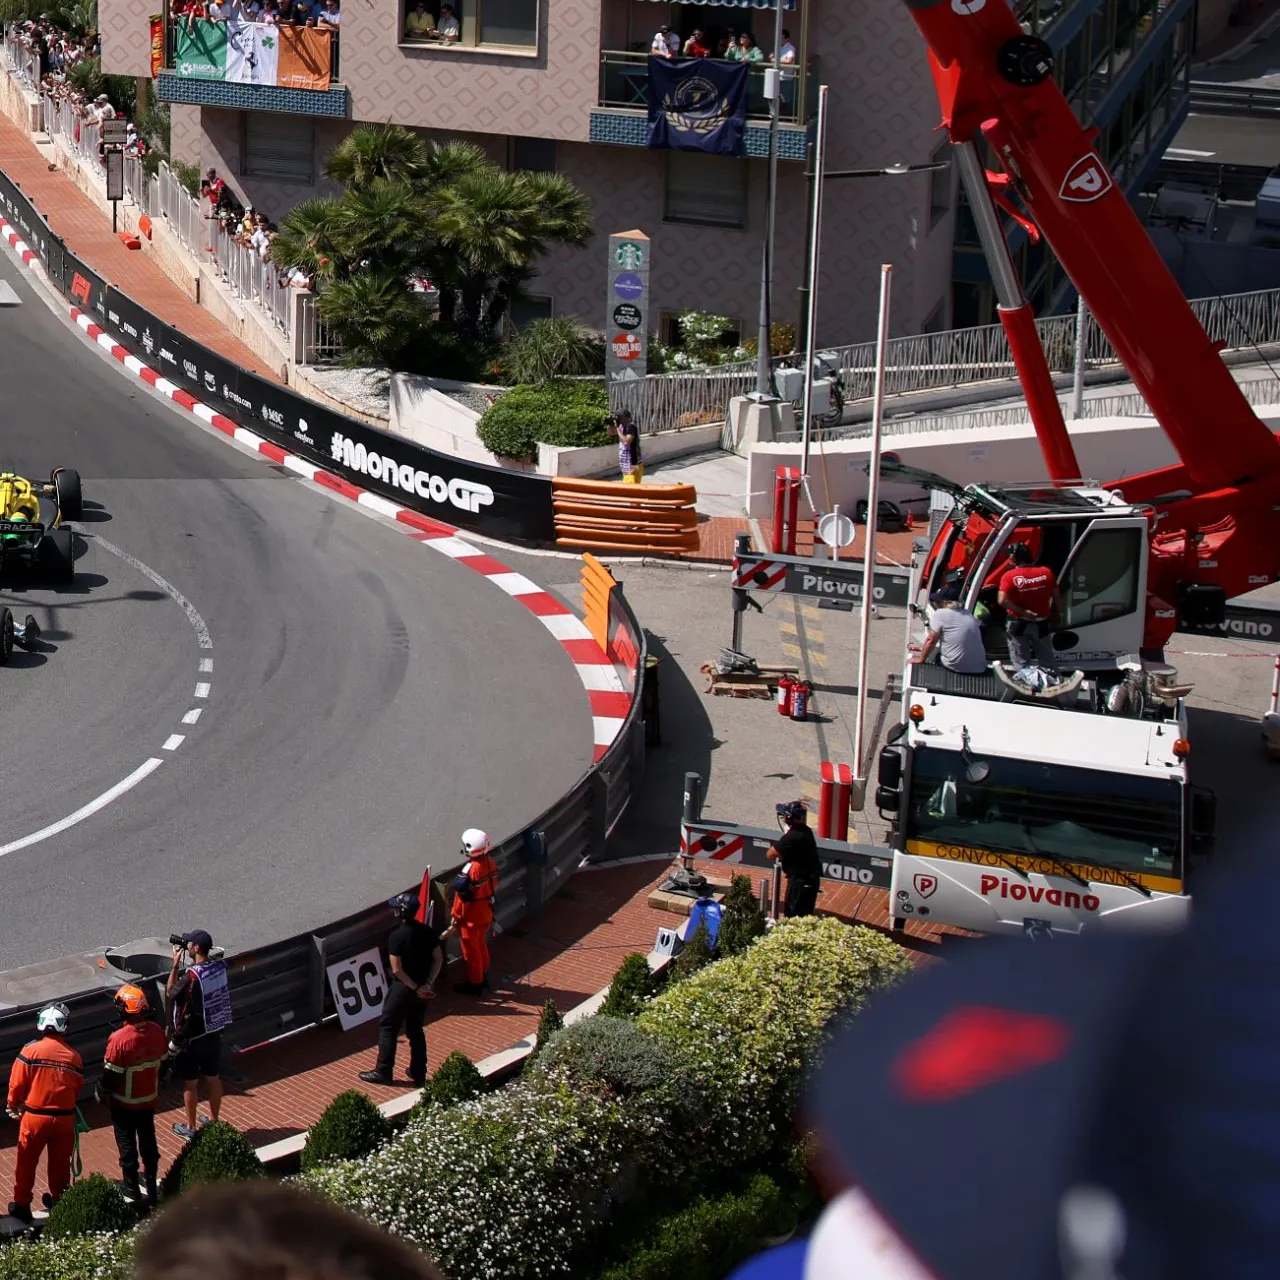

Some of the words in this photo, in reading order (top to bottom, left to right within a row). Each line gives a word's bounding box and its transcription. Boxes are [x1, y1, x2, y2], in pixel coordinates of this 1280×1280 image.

[269, 407, 285, 426] MSC
[331, 432, 495, 514] #MonacoGP
[803, 575, 885, 601] Piovao
[821, 861, 874, 884] vano
[980, 874, 1100, 912] Piovano
[337, 962, 383, 1016] SC
